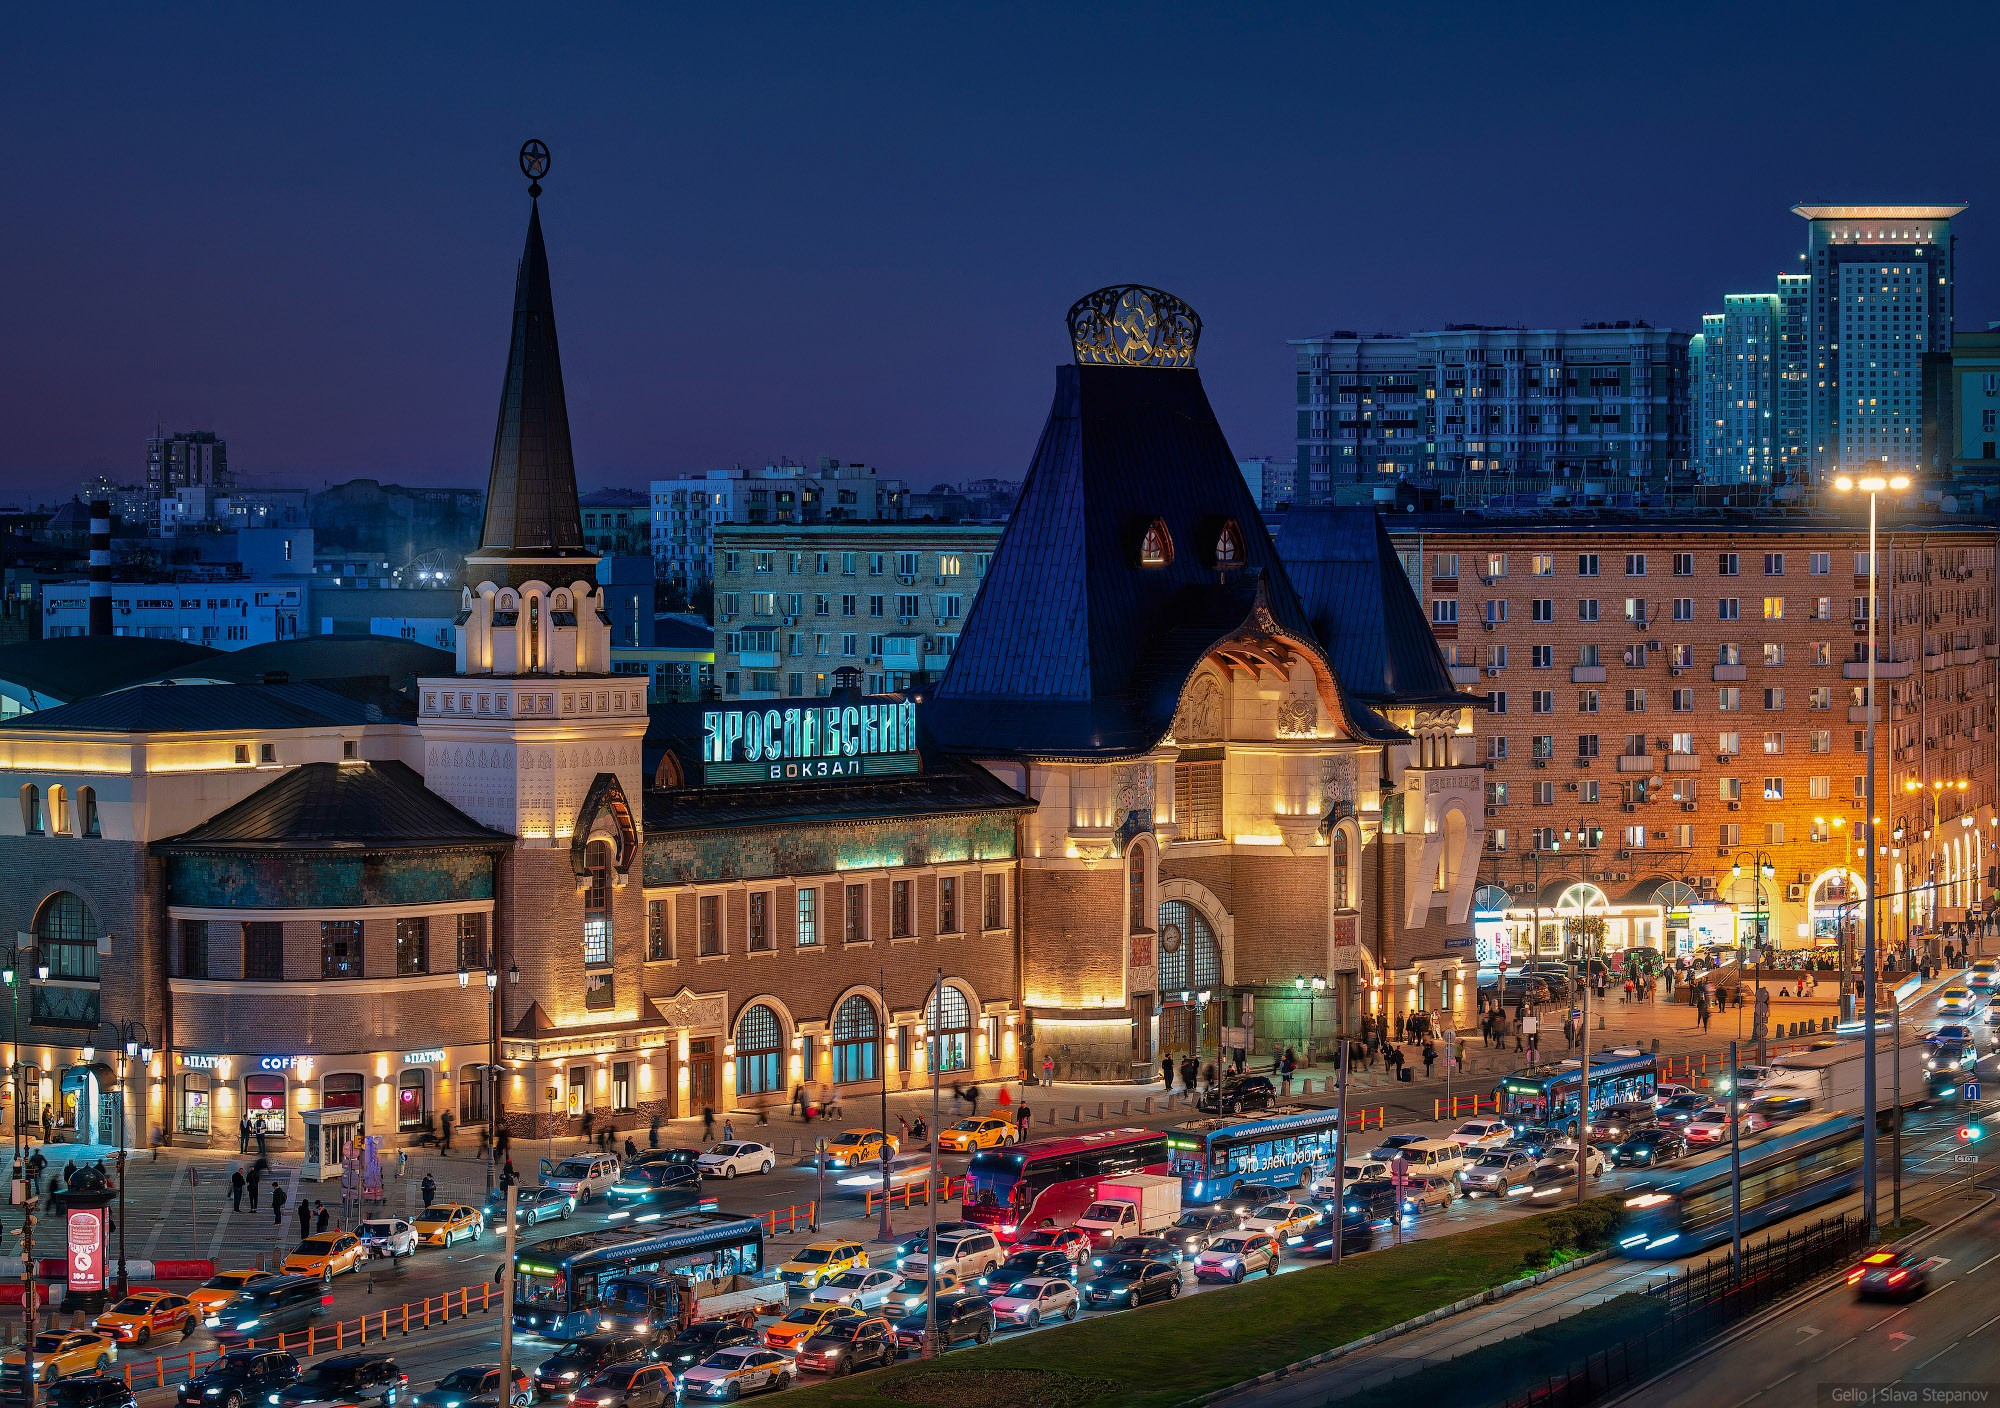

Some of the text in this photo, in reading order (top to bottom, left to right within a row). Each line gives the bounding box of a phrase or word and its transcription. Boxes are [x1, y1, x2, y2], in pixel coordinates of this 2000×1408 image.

[704, 699, 916, 762] ЯРОСЛАВСКИЙ
[770, 761, 859, 779] ВОКЗАЛ
[411, 1050, 446, 1063] ПАТИО
[1238, 1155, 1258, 1175] Это
[73, 1272, 86, 1280] 100
